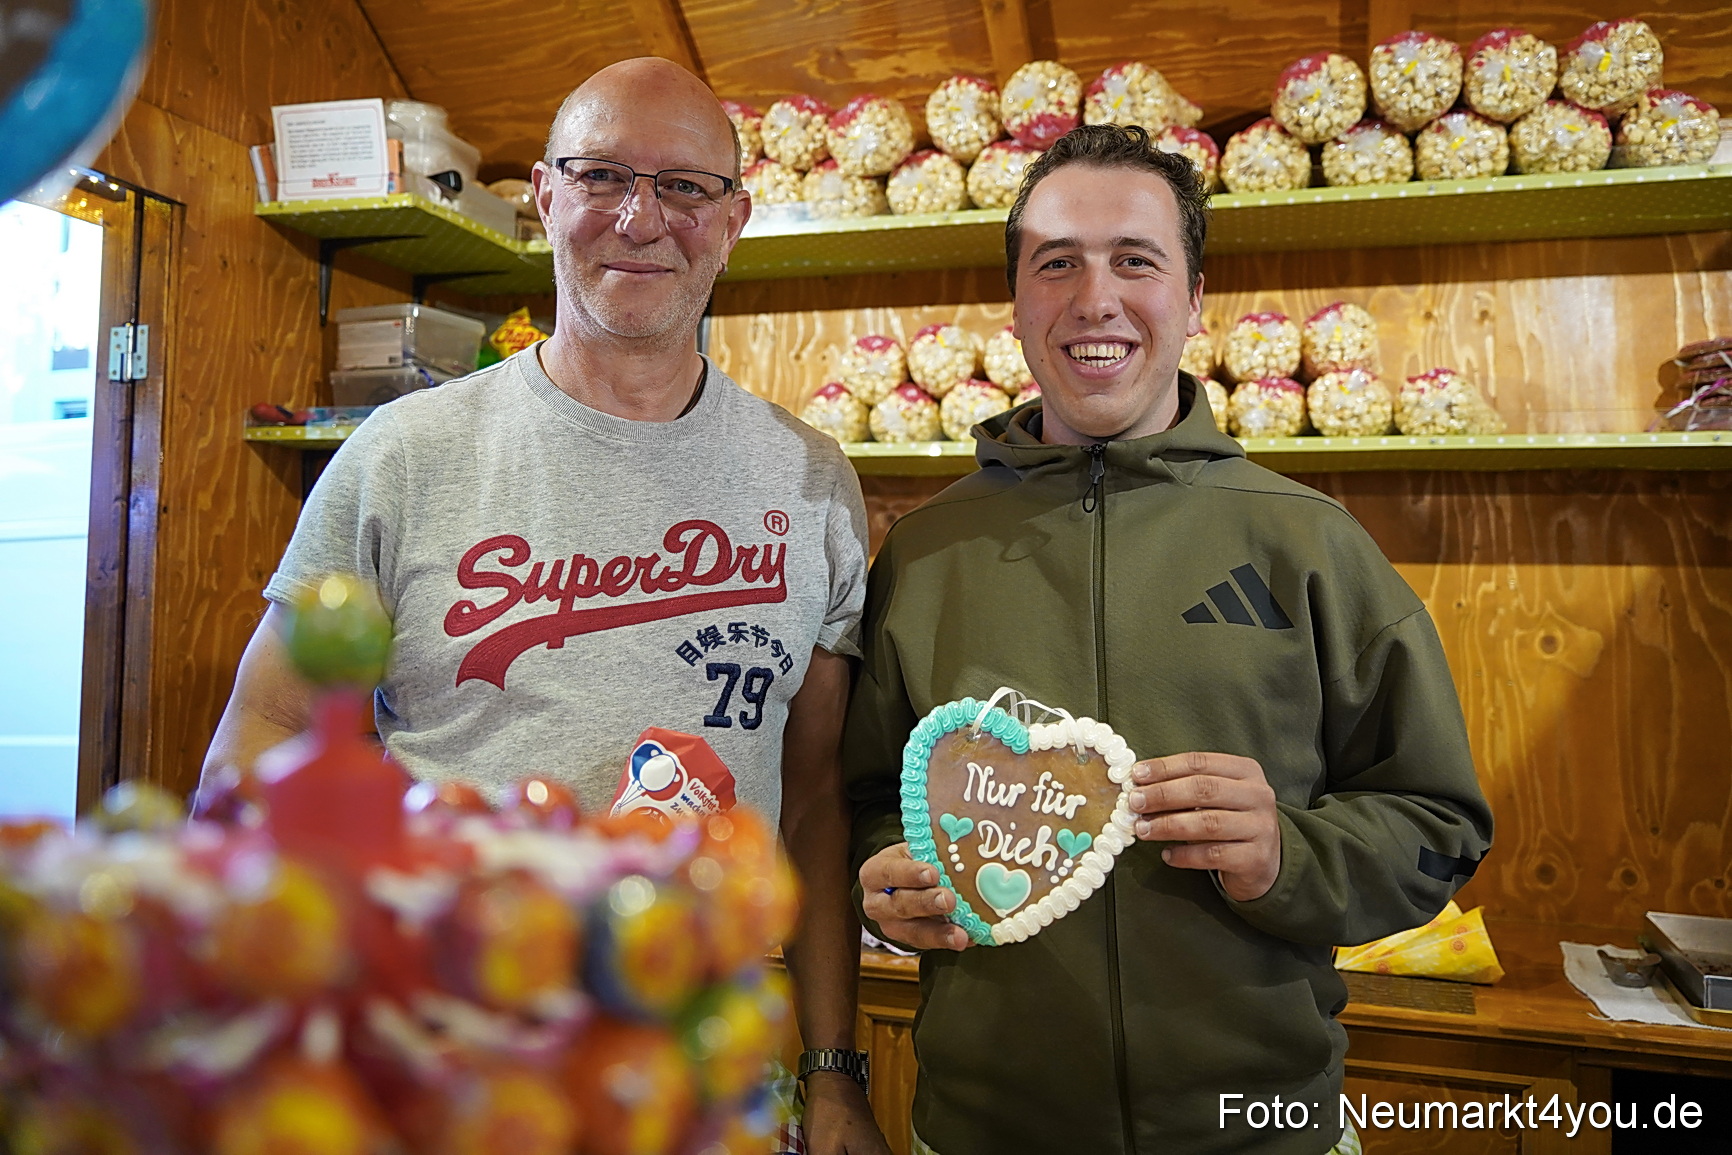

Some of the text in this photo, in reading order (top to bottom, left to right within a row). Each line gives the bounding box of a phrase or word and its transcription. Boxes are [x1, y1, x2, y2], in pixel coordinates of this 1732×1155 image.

[444, 519, 788, 649] SuperDry
[704, 663, 774, 730] 79
[963, 762, 1087, 819] Nur für
[977, 819, 1059, 871] Dich
